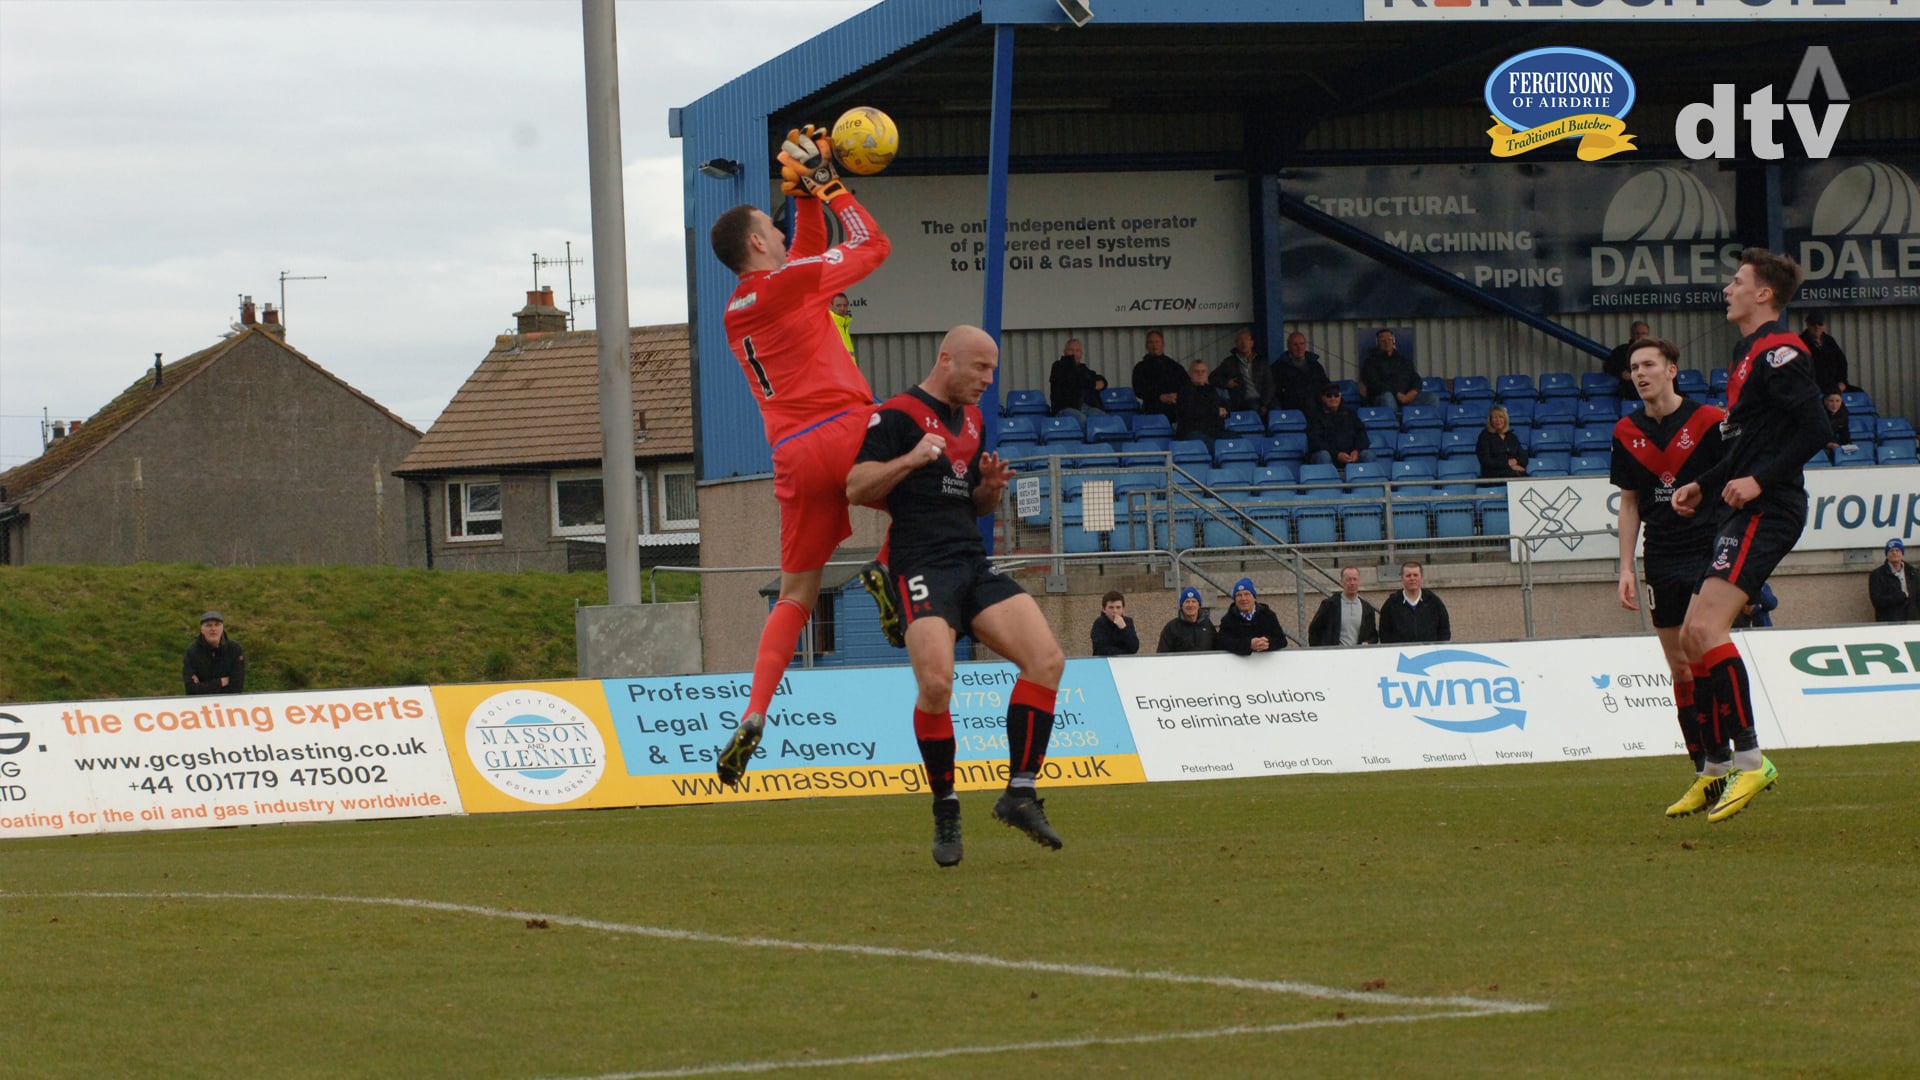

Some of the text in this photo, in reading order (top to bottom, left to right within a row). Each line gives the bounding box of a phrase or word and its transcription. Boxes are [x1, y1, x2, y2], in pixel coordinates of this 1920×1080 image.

[921, 215, 1197, 235] The onl independent operator
[950, 234, 1171, 256] of pered reel systems
[1384, 231, 1534, 253] MACHINING
[950, 257, 969, 272] to
[1009, 256, 1034, 270] Oil
[1039, 256, 1052, 270] &
[1058, 255, 1093, 269] Gas
[1098, 252, 1172, 270] Industry
[1591, 243, 1744, 286] DALES
[1474, 265, 1564, 288] PIPING
[849, 297, 867, 306] .uk
[1592, 290, 1723, 306] ENGINEERING SERVI
[1801, 284, 1920, 301] ENGINEERING SER
[1115, 297, 1241, 312] an ACTEON company
[742, 335, 774, 399] 1
[1806, 490, 1920, 540] roup
[908, 575, 929, 601] 5
[627, 676, 794, 703] Professioal
[1377, 675, 1522, 709] twma
[1617, 673, 1673, 689] @TWM
[951, 690, 1003, 709] 1779
[1135, 689, 1327, 713] Engineering solutions
[1624, 695, 1677, 708] twma.
[61, 696, 424, 736] the coating experts
[481, 698, 577, 725] SOLICITORS
[636, 708, 838, 736] Legal Svices
[1157, 709, 1319, 730] to eliminate waste
[480, 725, 588, 745] MASSON
[75, 737, 428, 772] www.gcgshotblasting.co.uk
[484, 746, 596, 769] GLENNIE
[648, 738, 877, 765] & Este Agency
[1181, 762, 1234, 774] Peterhead
[1263, 759, 1299, 771] Bridge
[1300, 758, 1311, 768] of
[1312, 757, 1333, 768] Don
[1361, 755, 1392, 766] Tullos
[1422, 752, 1467, 763] Shetland
[1495, 748, 1534, 760] Norway
[1562, 744, 1593, 757] Egypt
[1622, 741, 1646, 751] UAE
[128, 764, 388, 794] +44 (0)1779 475002
[0, 784, 27, 801] TD
[0, 791, 448, 830] oating for the oil and gas industry worldwide.
